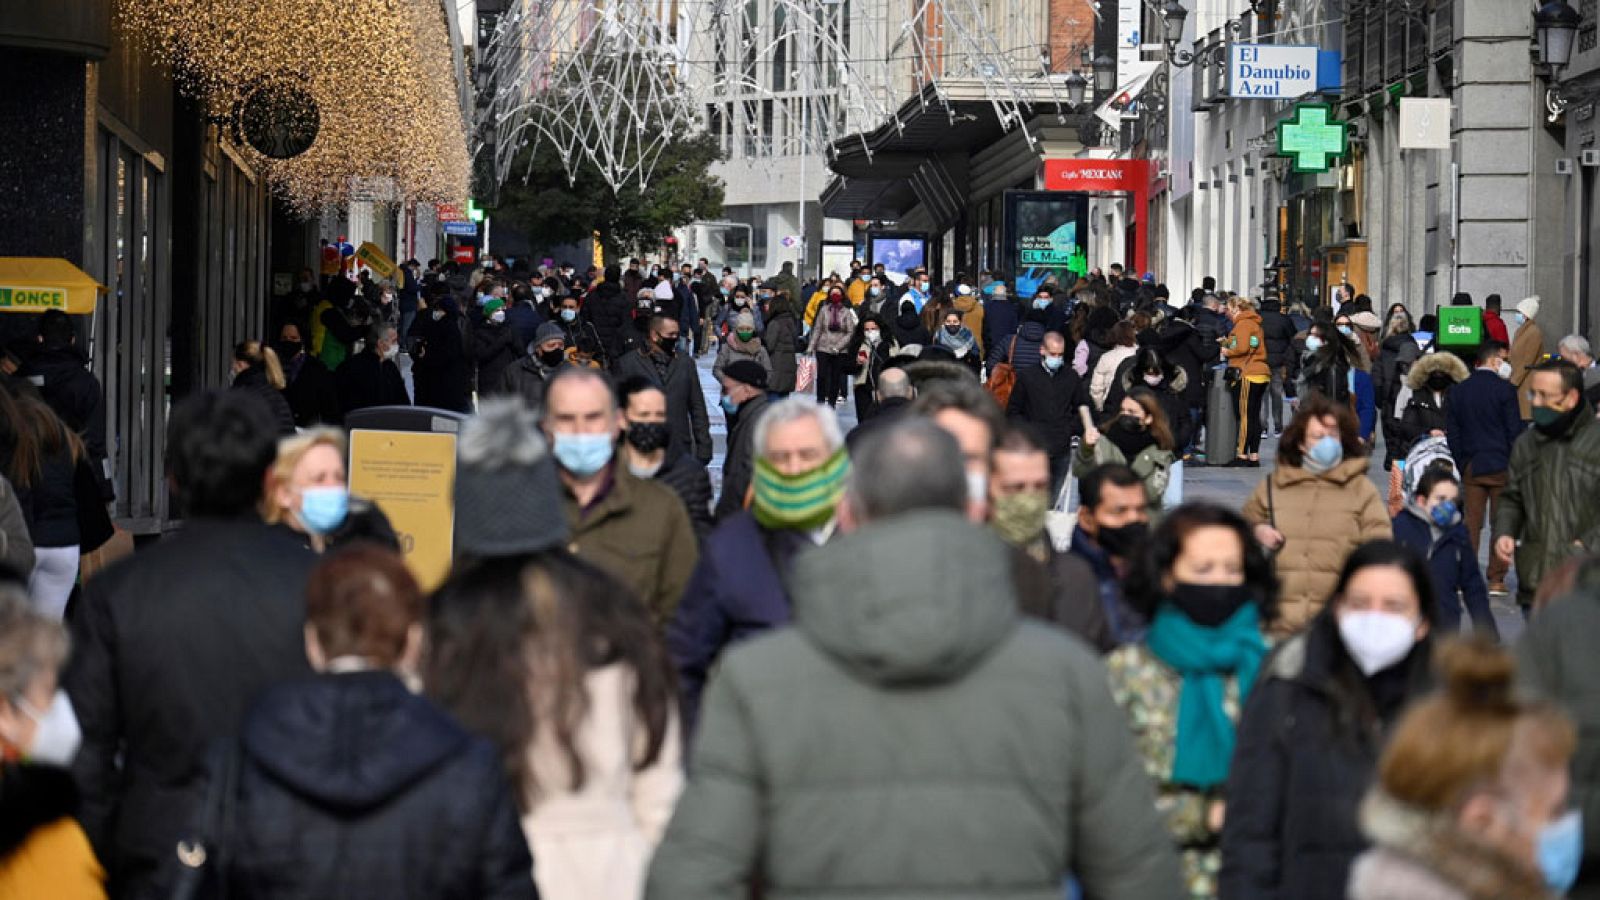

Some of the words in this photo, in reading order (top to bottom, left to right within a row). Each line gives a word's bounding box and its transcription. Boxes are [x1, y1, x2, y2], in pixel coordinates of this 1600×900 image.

[1240, 47, 1258, 62] El
[1239, 63, 1311, 80] Danubio
[1239, 80, 1279, 95] Azul
[1023, 251, 1037, 262] EL
[15, 291, 62, 305] ONCE
[1448, 324, 1472, 334] Eats
